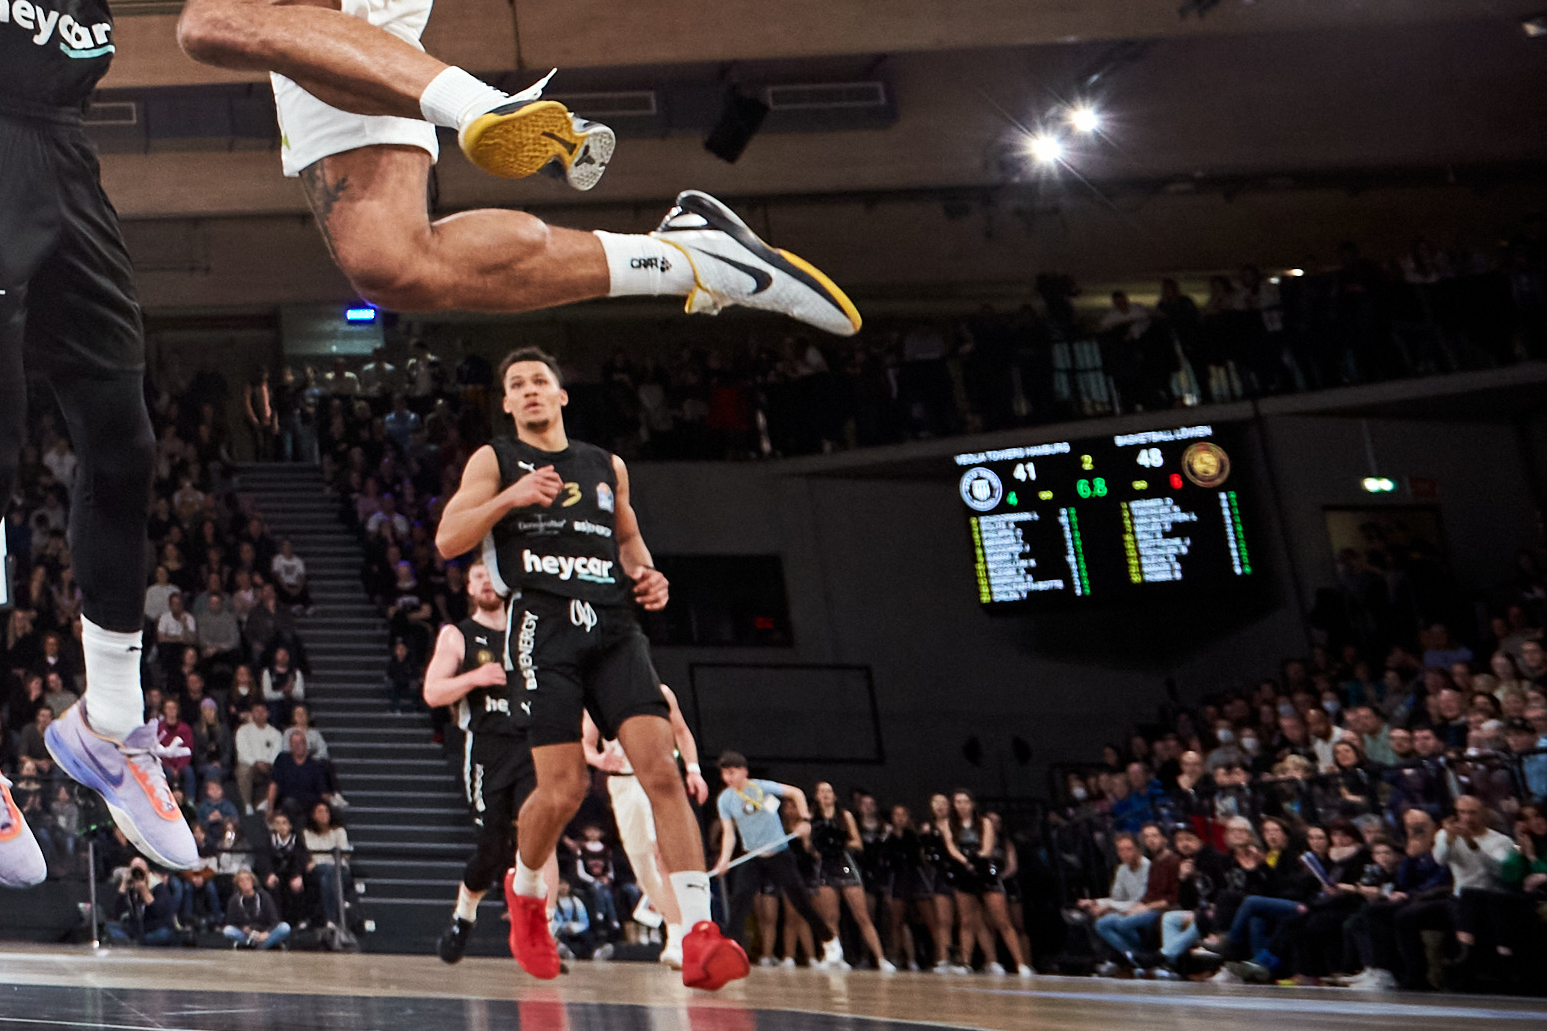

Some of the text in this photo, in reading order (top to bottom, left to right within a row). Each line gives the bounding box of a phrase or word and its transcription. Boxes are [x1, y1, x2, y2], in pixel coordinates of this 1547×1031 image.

[1013, 462, 1037, 482] 41
[561, 482, 583, 507] 3
[522, 549, 614, 581] heycar
